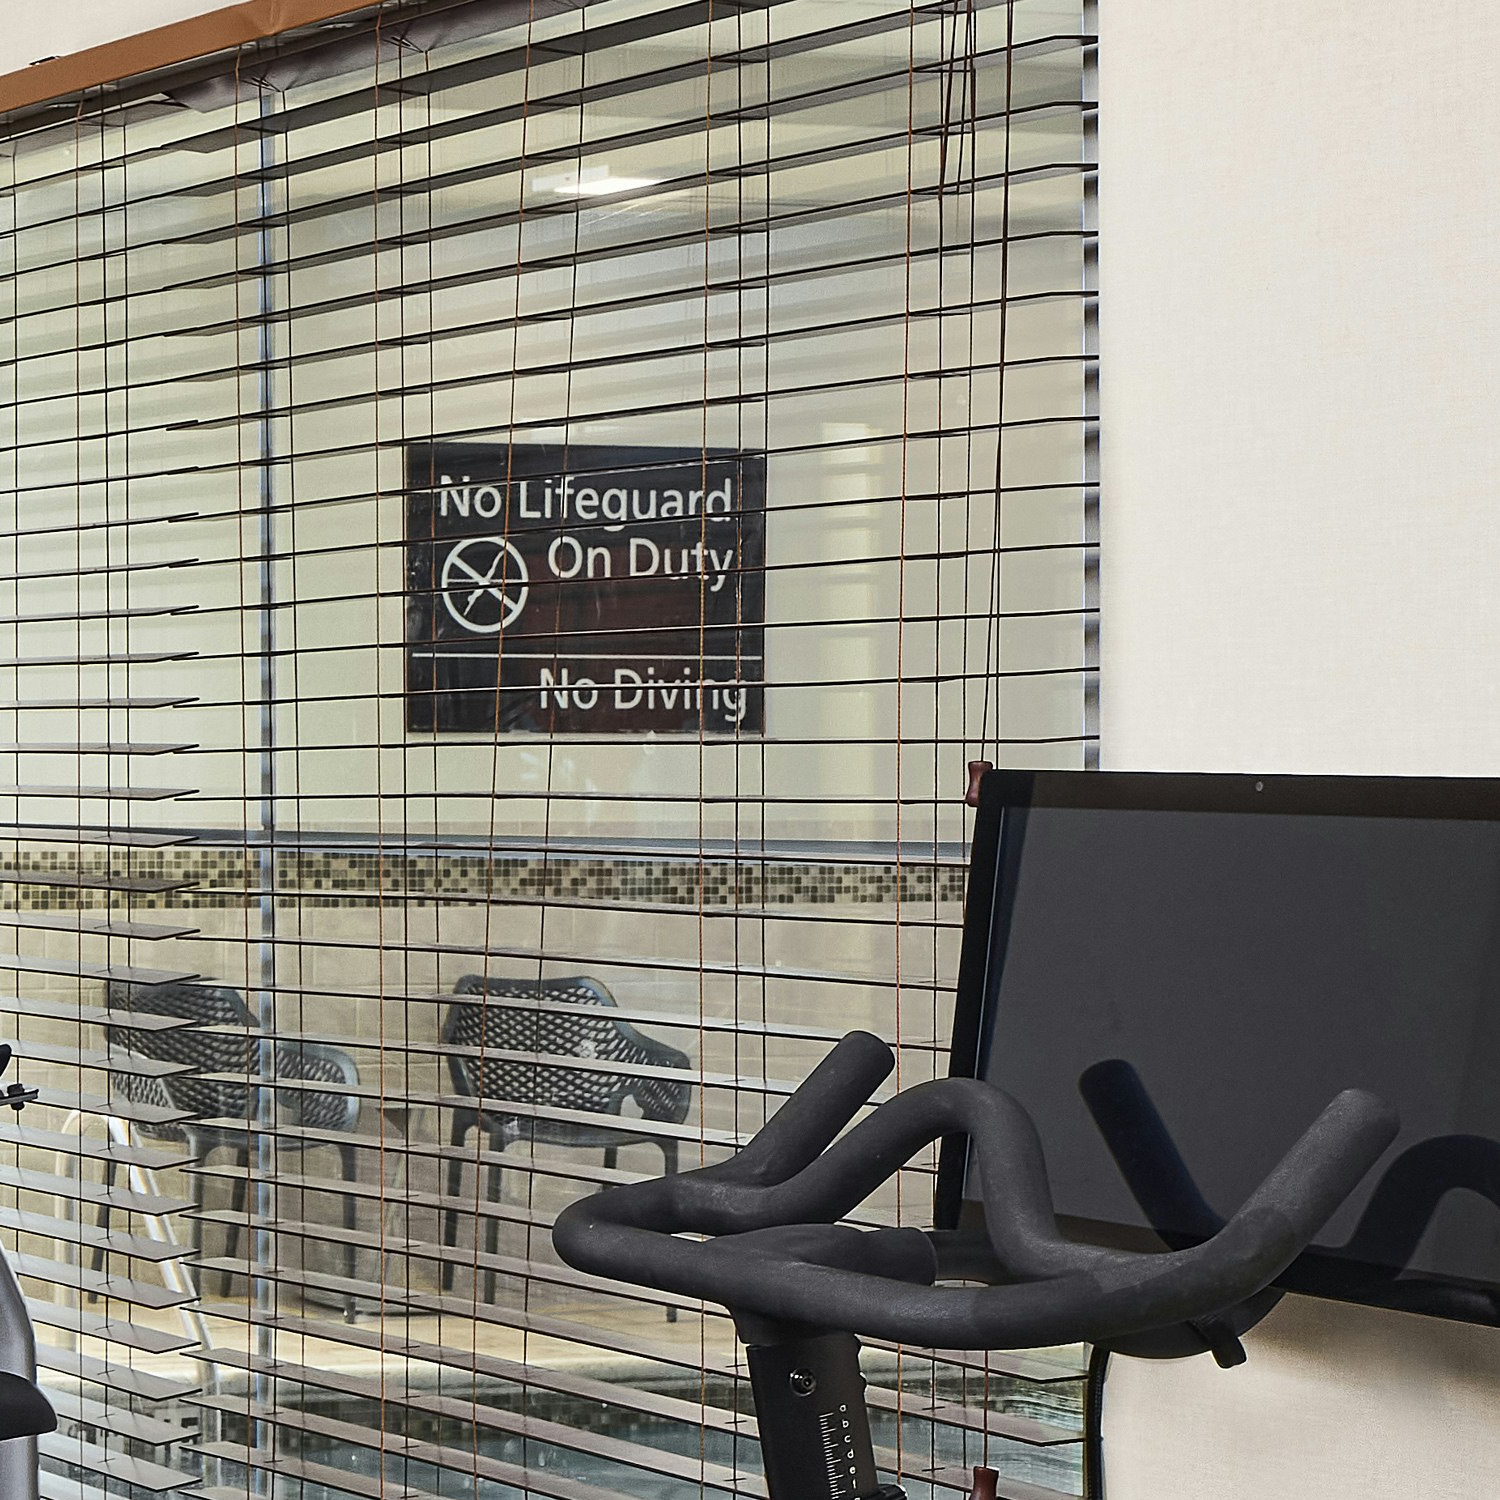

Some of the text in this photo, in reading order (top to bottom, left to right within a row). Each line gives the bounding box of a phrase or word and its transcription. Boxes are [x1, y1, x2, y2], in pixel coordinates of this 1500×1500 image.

[439, 475, 733, 531] No Lifeguard
[548, 535, 734, 592] On Duty
[539, 667, 747, 722] No Diving
[842, 1419, 849, 1428] b
[844, 1435, 851, 1443] c
[847, 1448, 854, 1459] d
